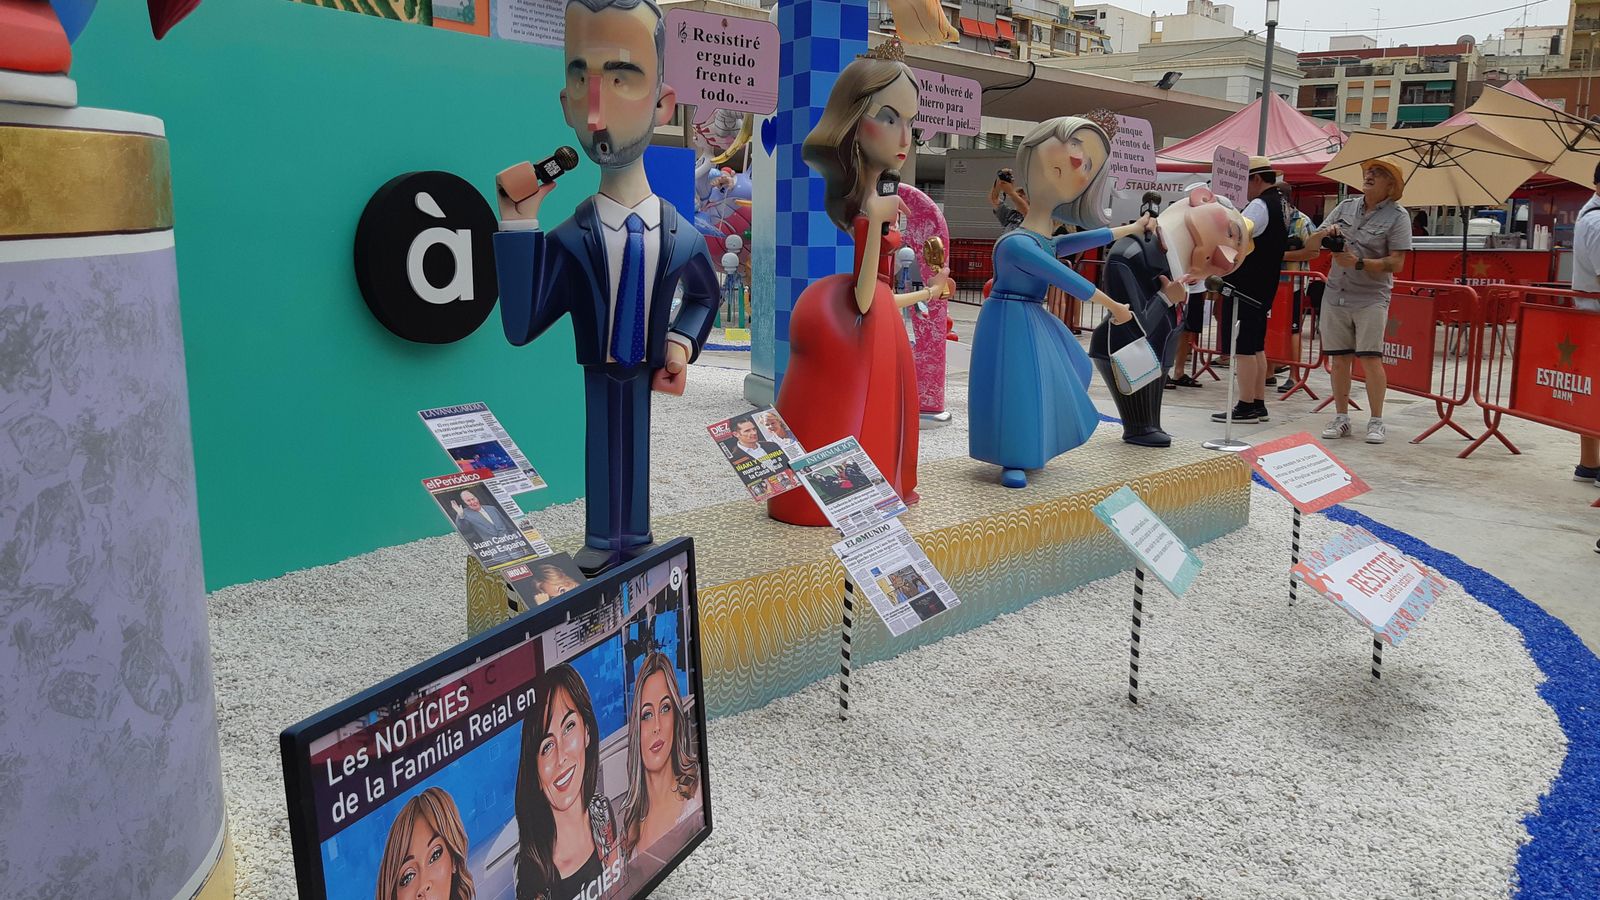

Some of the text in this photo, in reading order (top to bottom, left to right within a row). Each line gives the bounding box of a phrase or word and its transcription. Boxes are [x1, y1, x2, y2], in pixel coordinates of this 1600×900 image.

[693, 27, 761, 50] Resistiré
[696, 50, 755, 68] erguido
[696, 66, 755, 87] frente a
[701, 87, 748, 105] todo...
[920, 79, 974, 99] Me volveré de
[920, 95, 964, 113] hierro para
[947, 115, 954, 127] la
[1115, 137, 1151, 150] vientos de
[1112, 150, 1145, 162] mi nuera
[1130, 164, 1154, 176] fuertes
[1114, 181, 1184, 192] STAURANTE
[1454, 277, 1505, 286] ETRELLA
[1382, 342, 1413, 360] RELLA
[1536, 367, 1591, 395] ESTRELLA
[1552, 389, 1573, 402] DAMM
[710, 423, 729, 435] DIEZ
[806, 438, 856, 465] INFORMACIÓN
[742, 465, 760, 476] nuevo
[755, 468, 769, 478] Casa
[472, 540, 493, 550] Juan
[491, 533, 518, 546] Carlos
[479, 540, 527, 558] deja España
[326, 685, 470, 787] Les NOTÍCIES
[331, 687, 536, 823] de la Família Reial en
